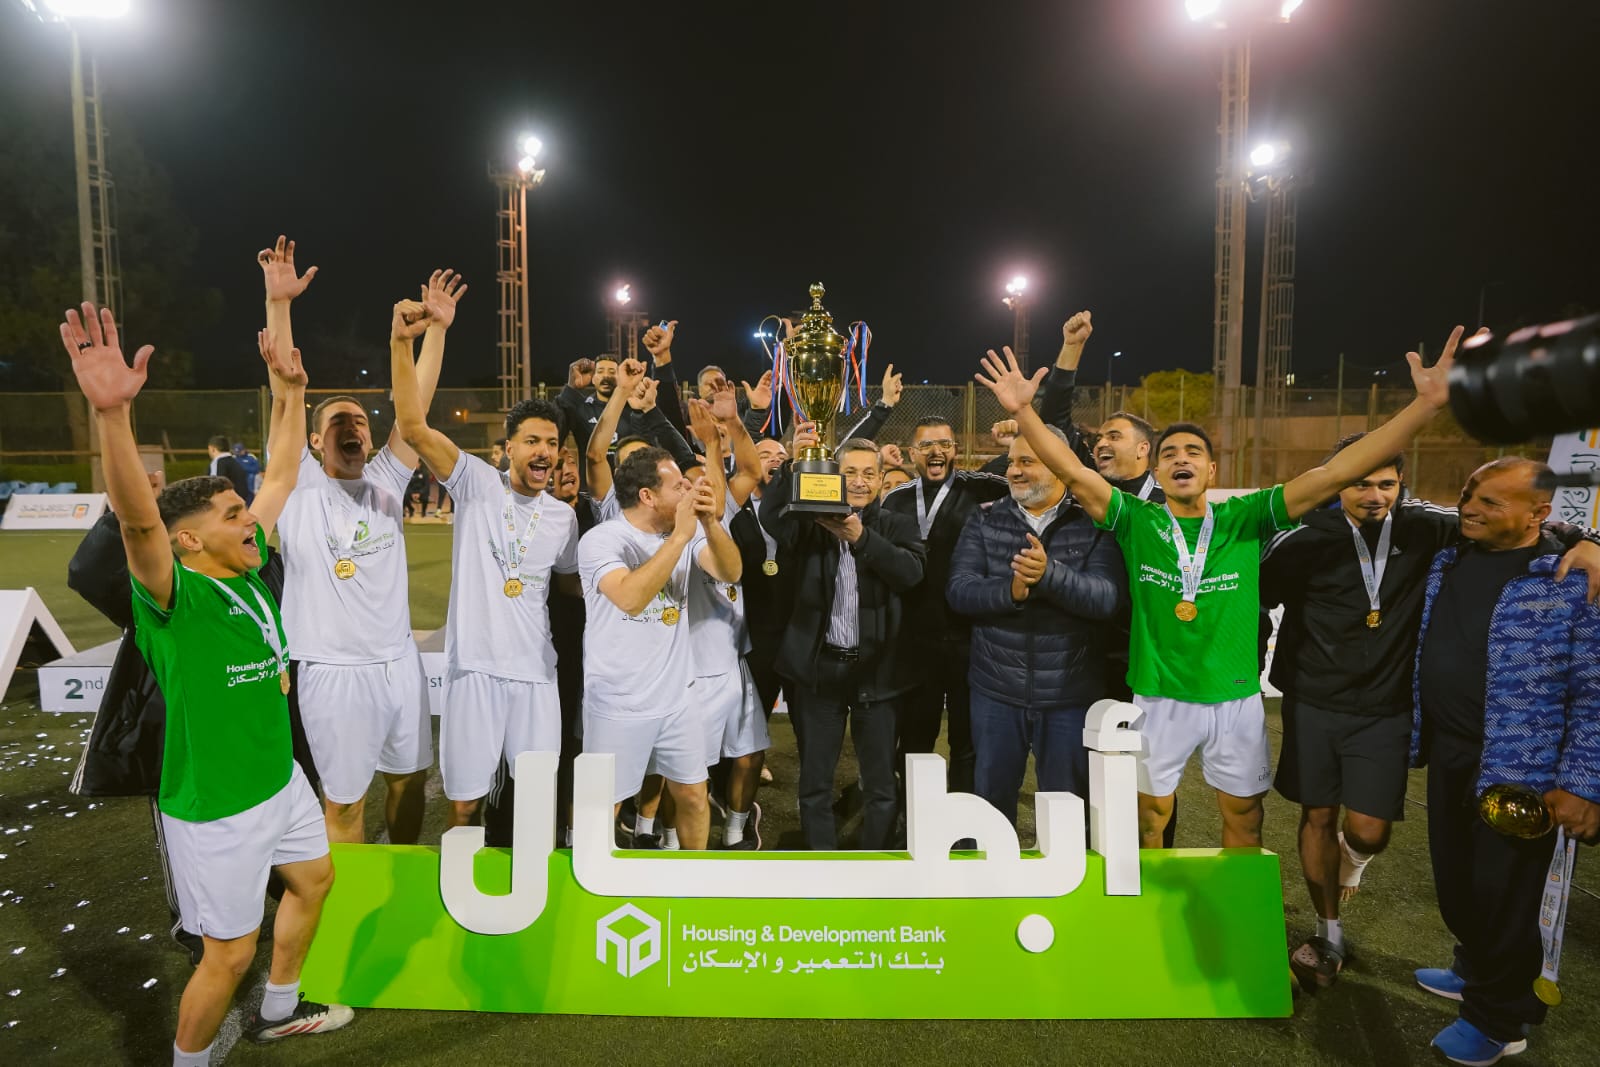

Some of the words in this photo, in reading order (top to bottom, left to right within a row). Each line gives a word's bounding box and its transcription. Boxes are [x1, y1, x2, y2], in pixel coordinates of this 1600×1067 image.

[1140, 563, 1168, 580] Housing
[1222, 572, 1239, 582] Bank
[226, 660, 265, 673] Housing
[64, 677, 104, 699] 2nd
[440, 699, 1144, 953] أبطال
[682, 925, 756, 945] Housing
[761, 926, 775, 942] &
[779, 926, 896, 946] Development
[900, 926, 946, 943] Bank
[682, 949, 767, 974] الإسكان
[771, 956, 784, 974] و
[789, 951, 882, 974] التعمير
[888, 951, 945, 974] بنك
